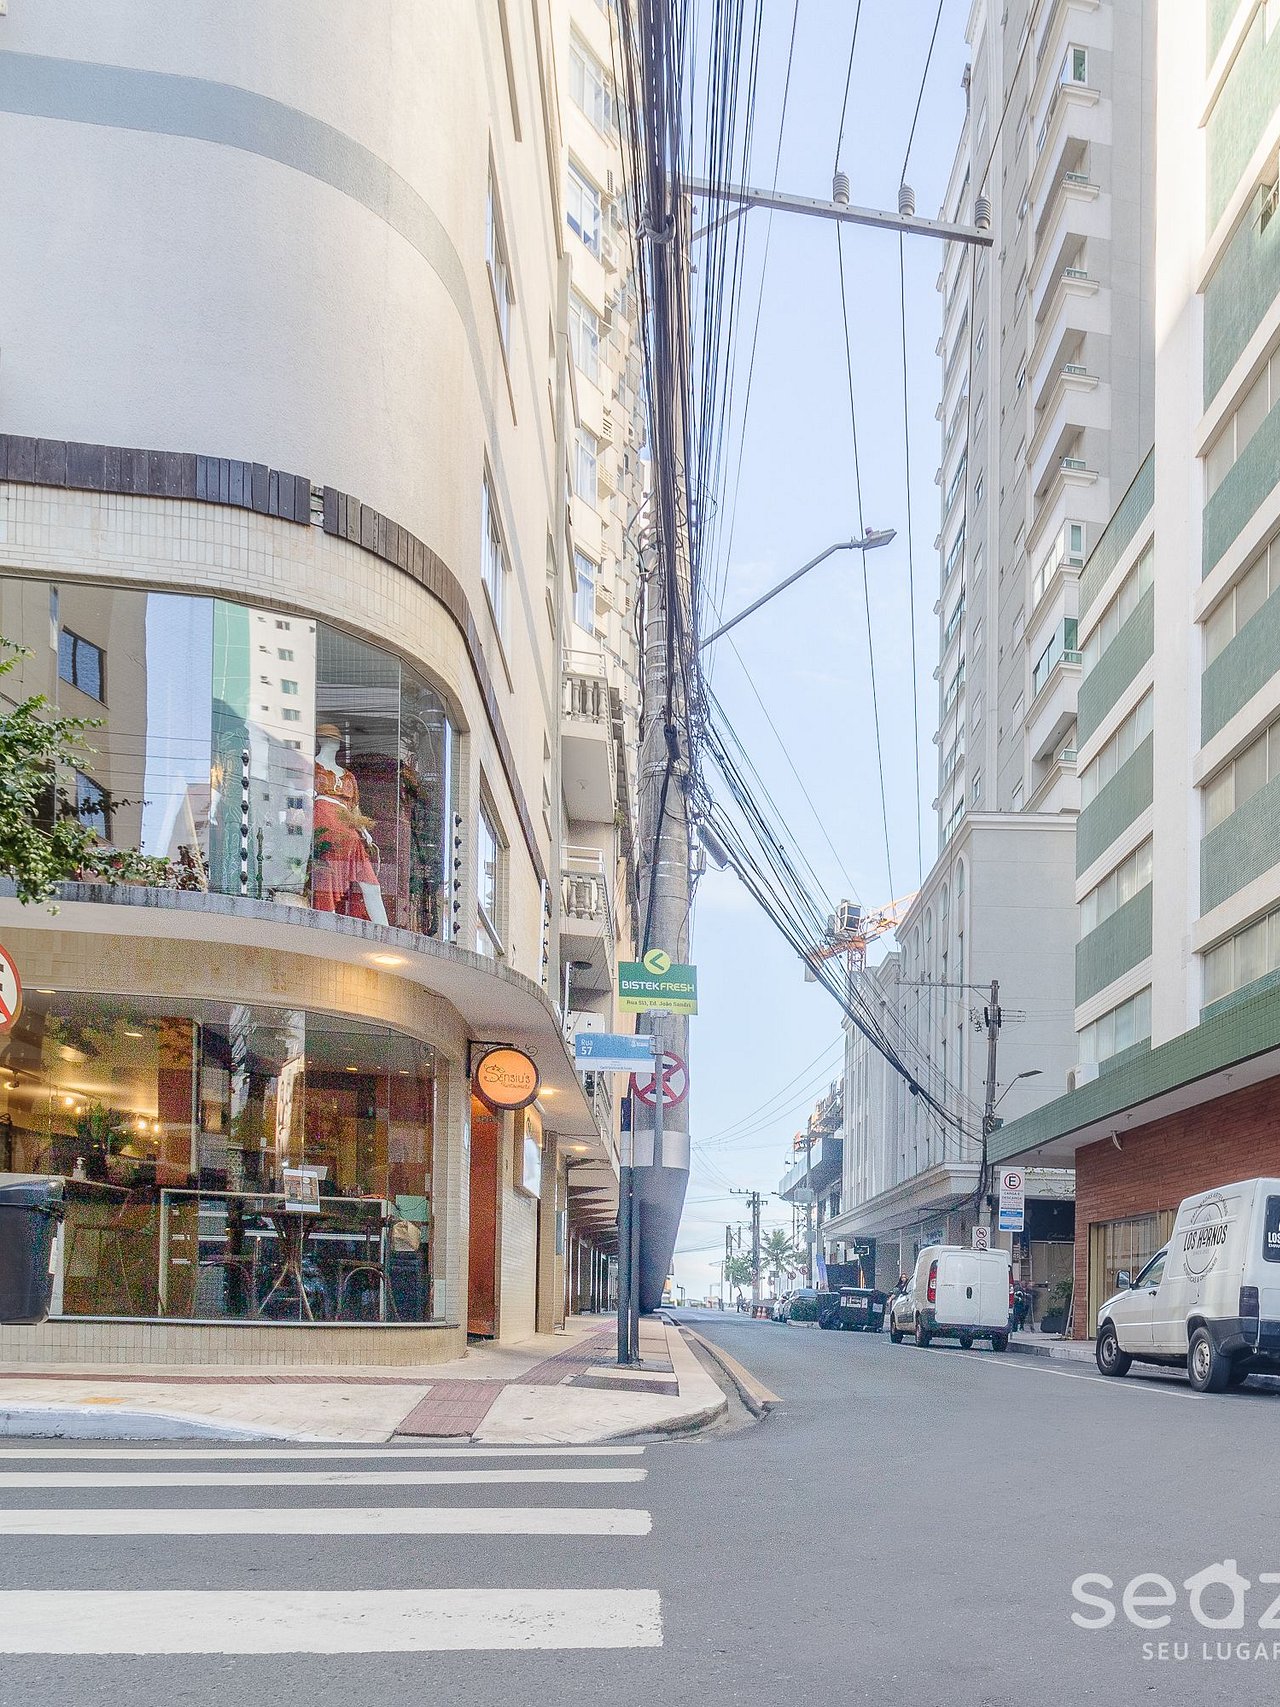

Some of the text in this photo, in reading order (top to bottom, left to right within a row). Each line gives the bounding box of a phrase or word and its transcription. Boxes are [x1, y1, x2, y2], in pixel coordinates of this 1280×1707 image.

[581, 1047, 593, 1055] 57
[1008, 1176, 1016, 1187] E
[1183, 1224, 1228, 1252] LOS HORNOS
